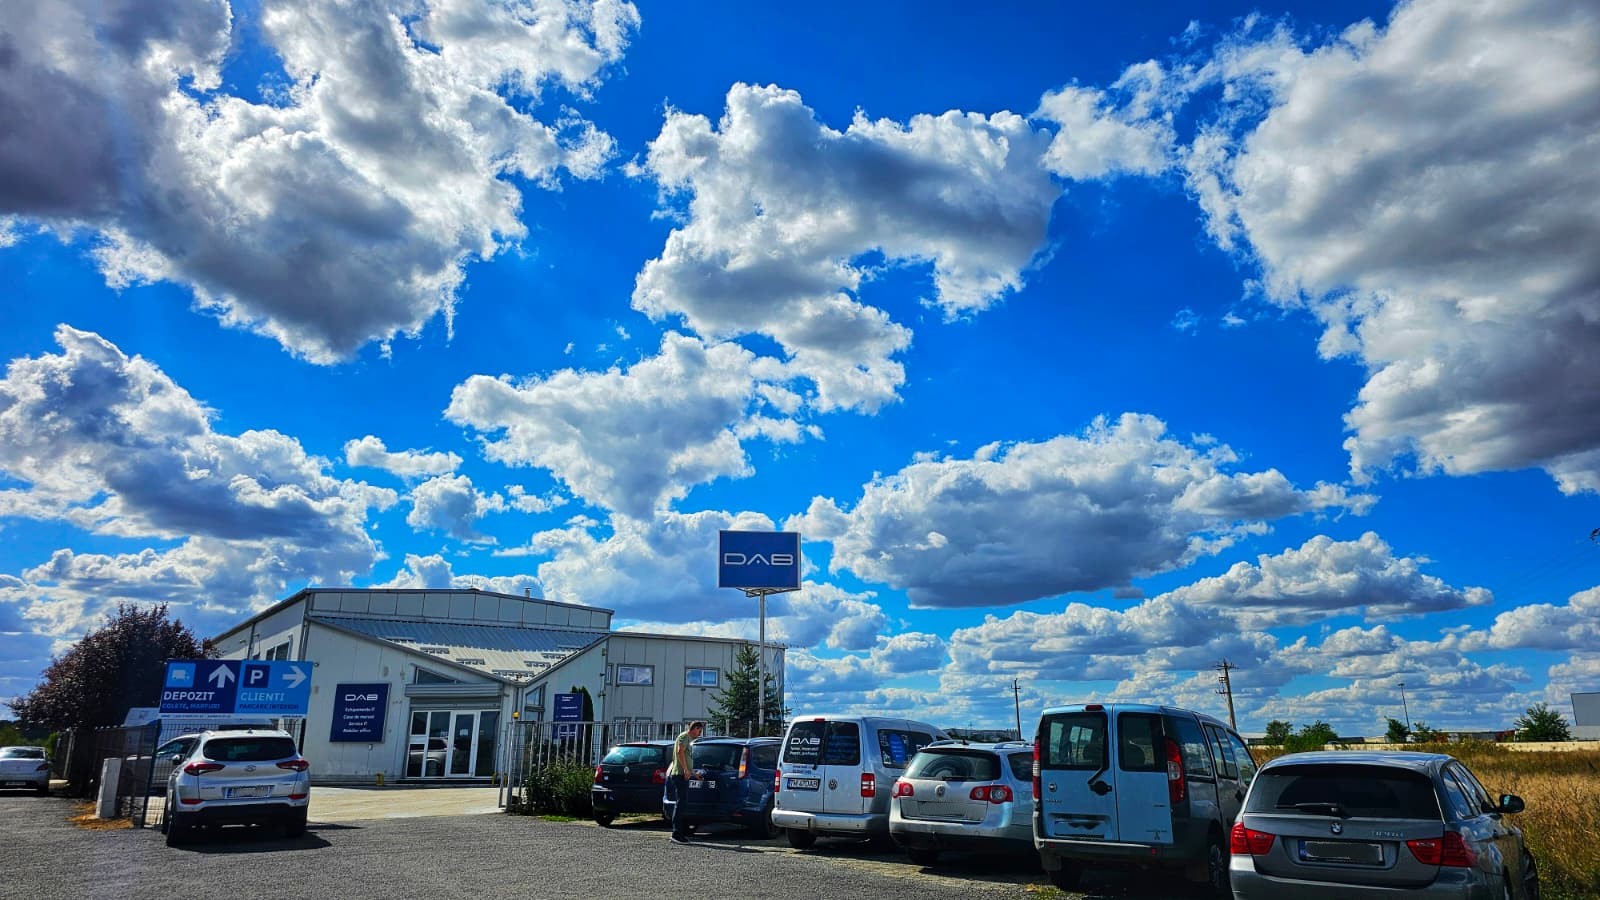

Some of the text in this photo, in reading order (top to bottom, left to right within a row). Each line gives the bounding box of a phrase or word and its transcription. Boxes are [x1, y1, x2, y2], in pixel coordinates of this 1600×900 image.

[724, 552, 793, 566] DAB
[250, 669, 264, 685] P
[163, 691, 216, 702] DEPOZIT
[240, 692, 285, 702] CLIENTI
[791, 737, 821, 745] DAB
